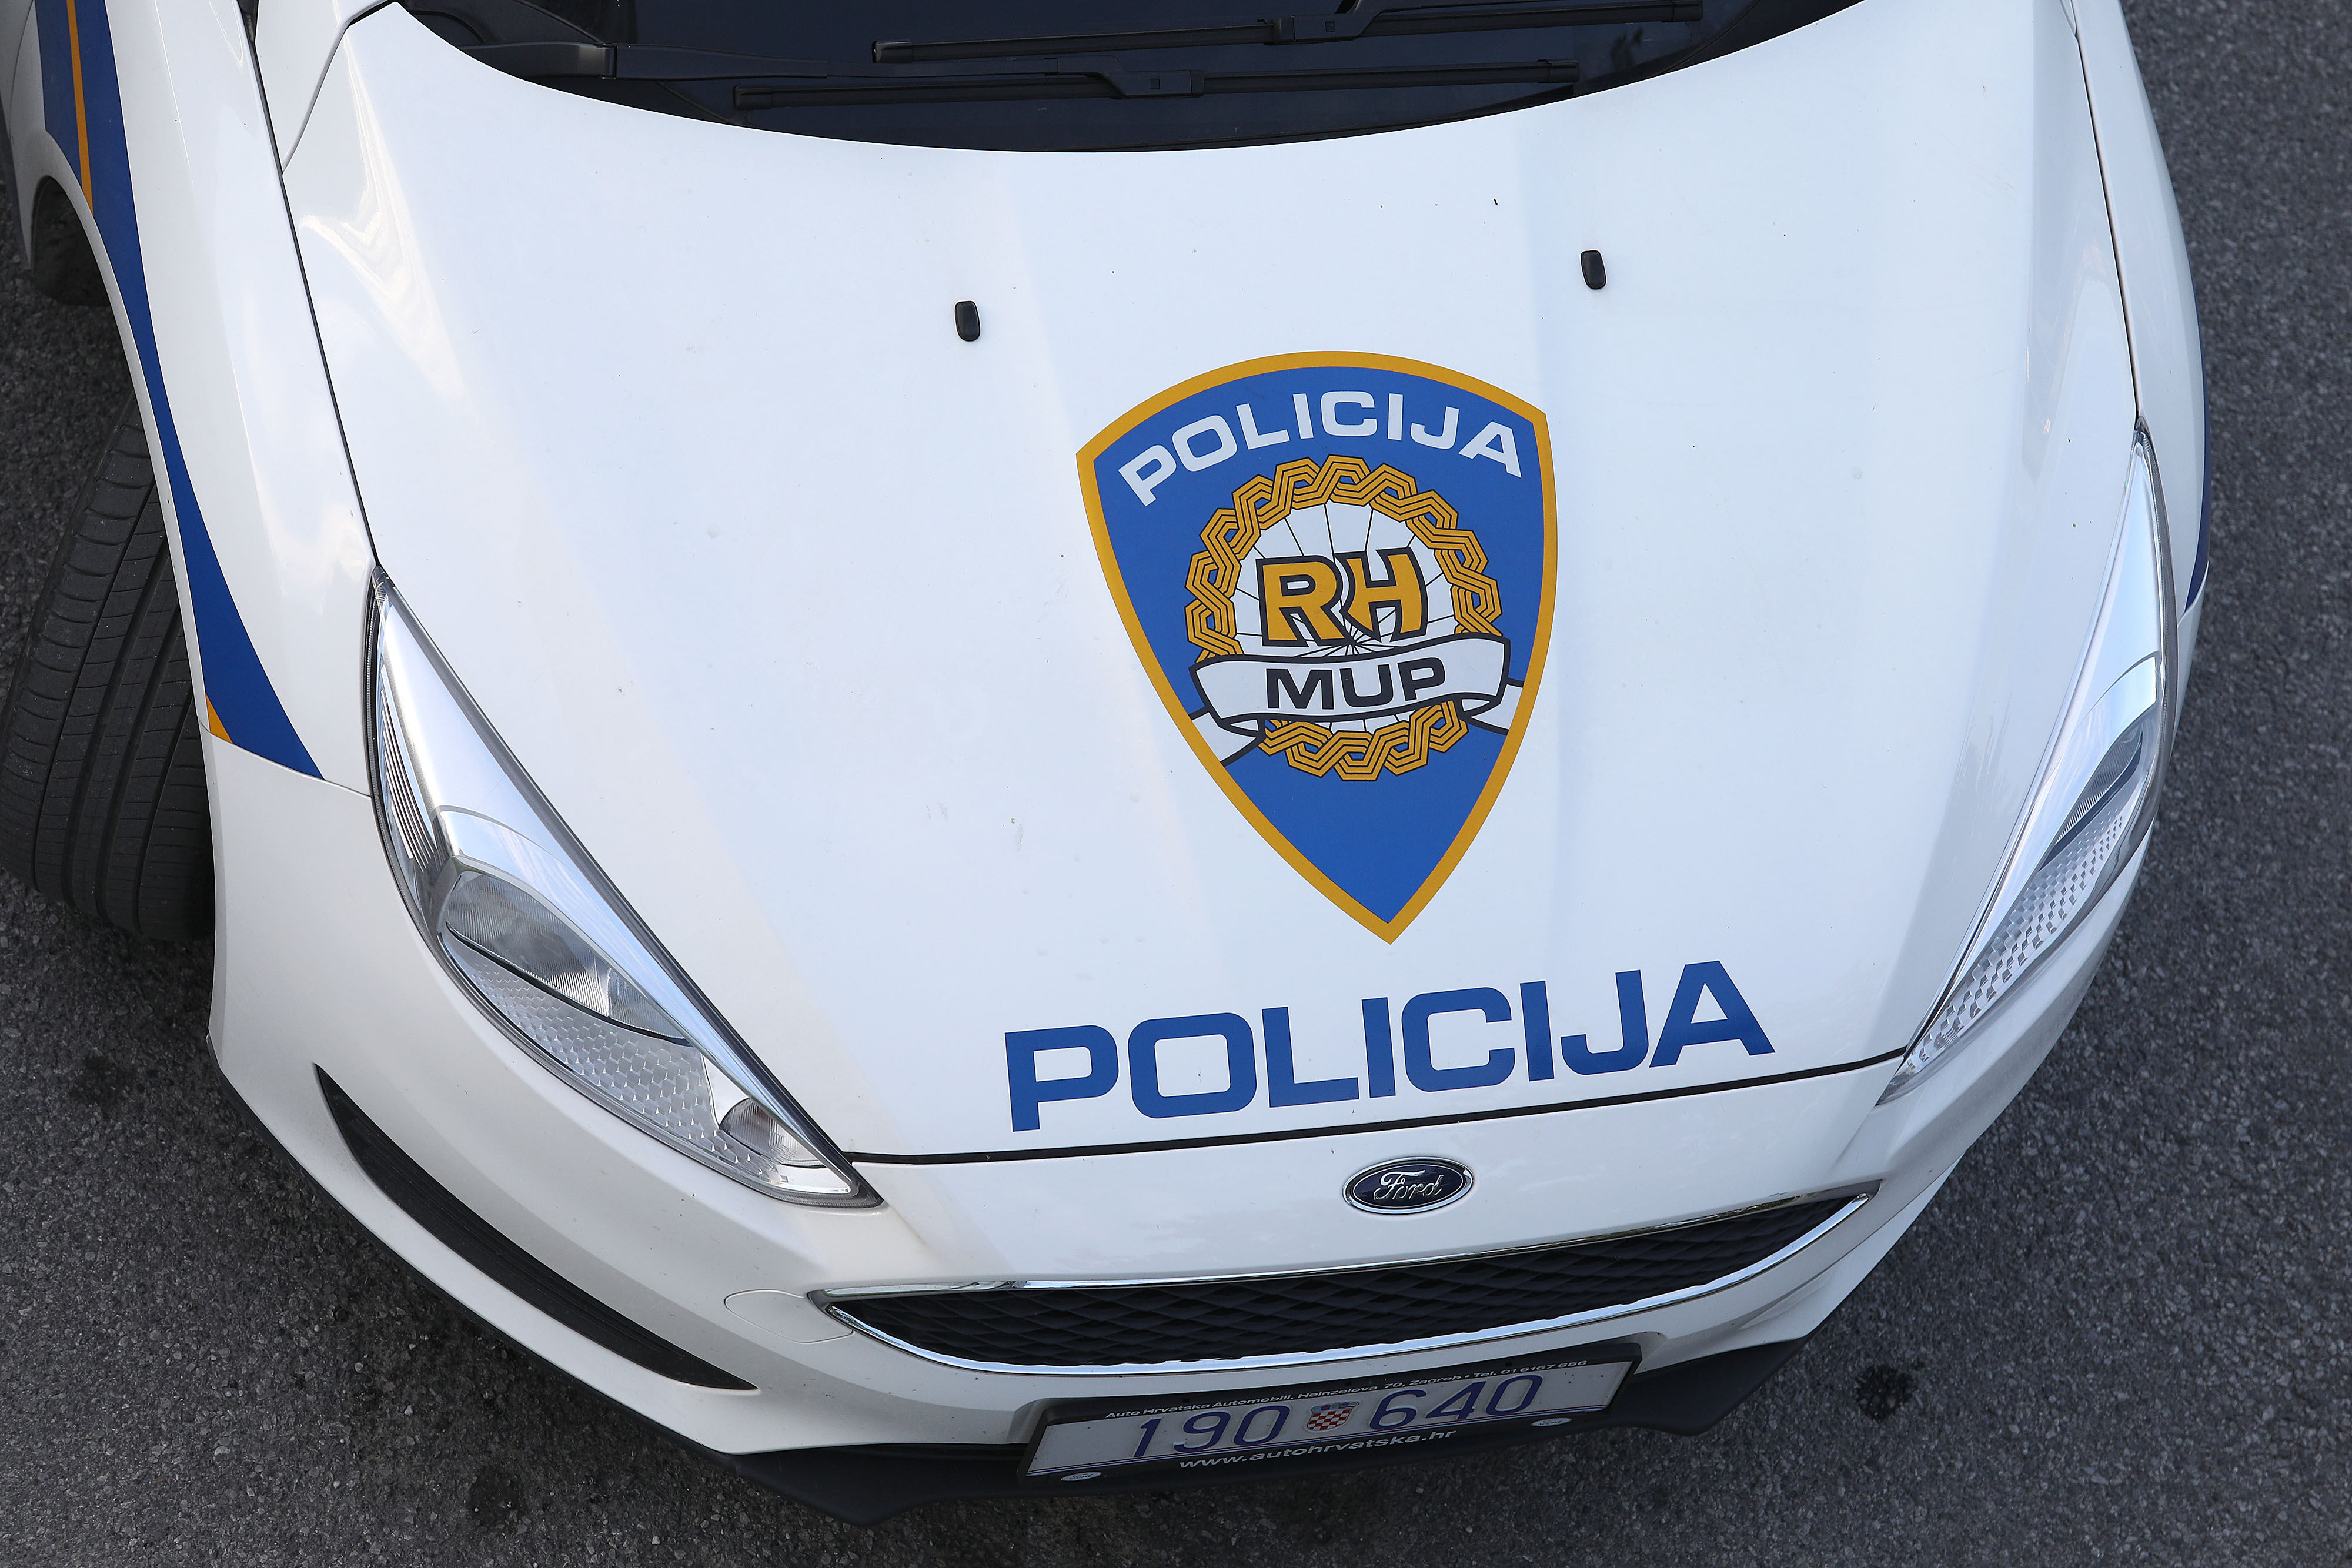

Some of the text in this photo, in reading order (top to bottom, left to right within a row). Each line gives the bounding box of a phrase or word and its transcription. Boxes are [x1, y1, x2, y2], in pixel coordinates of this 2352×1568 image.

[1118, 391, 1522, 507] POLICIJA
[1256, 547, 1428, 647] RH
[1267, 657, 1446, 710] MUP
[1005, 960, 1776, 1131] POLICIJA
[1373, 1169, 1444, 1201] Ford
[1132, 1375, 1544, 1457] 190 640
[1142, 1403, 1210, 1415] Hrvatska
[1298, 1385, 1378, 1398] Heinzelova
[1409, 1375, 1462, 1386] Zagreb
[1180, 1430, 1456, 1468] www.autohrvatska.hr
